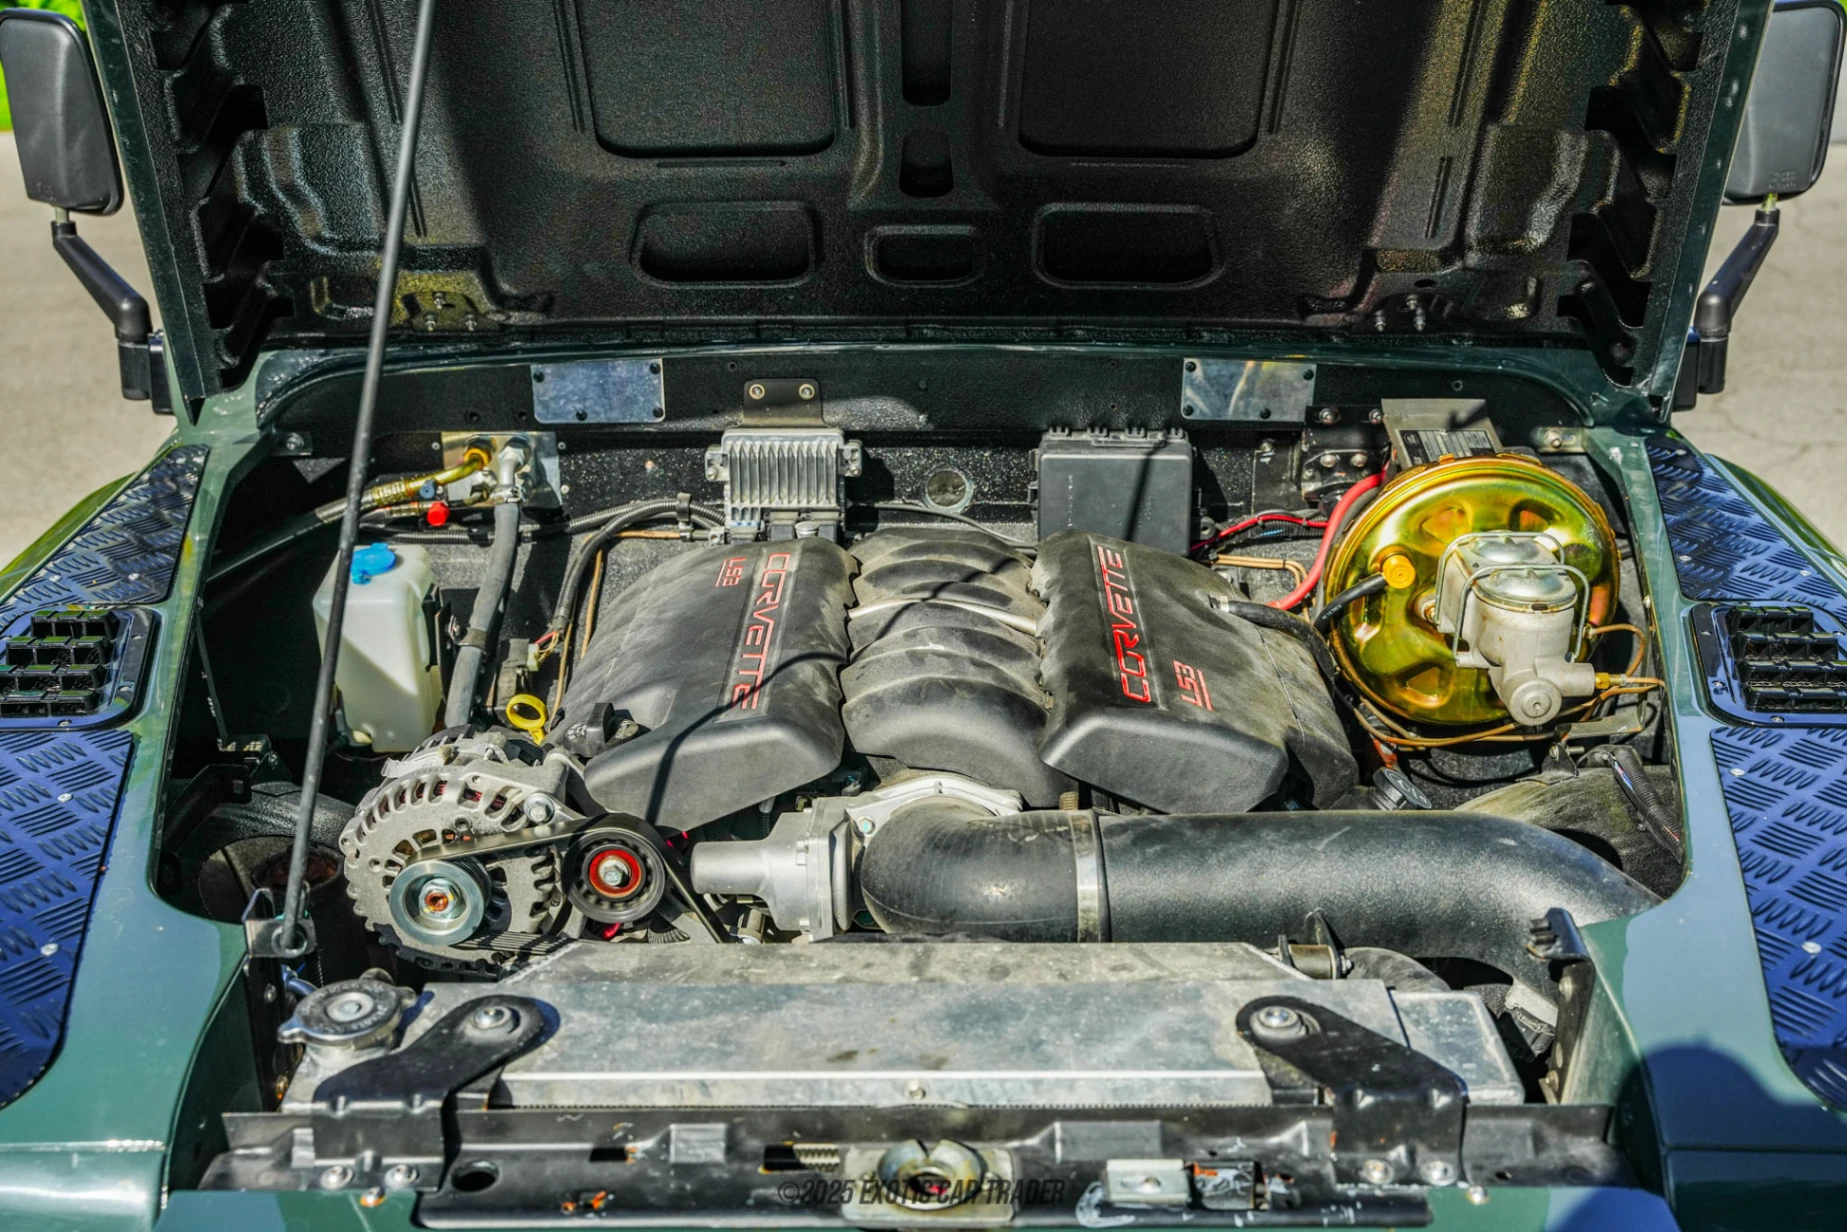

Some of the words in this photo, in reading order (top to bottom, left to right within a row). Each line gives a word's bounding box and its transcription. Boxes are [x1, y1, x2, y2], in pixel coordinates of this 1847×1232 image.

[722, 557, 746, 586] LS3
[732, 553, 790, 710] CORVETTE
[1098, 546, 1151, 703] CORVETTE
[1173, 660, 1202, 707] LS3
